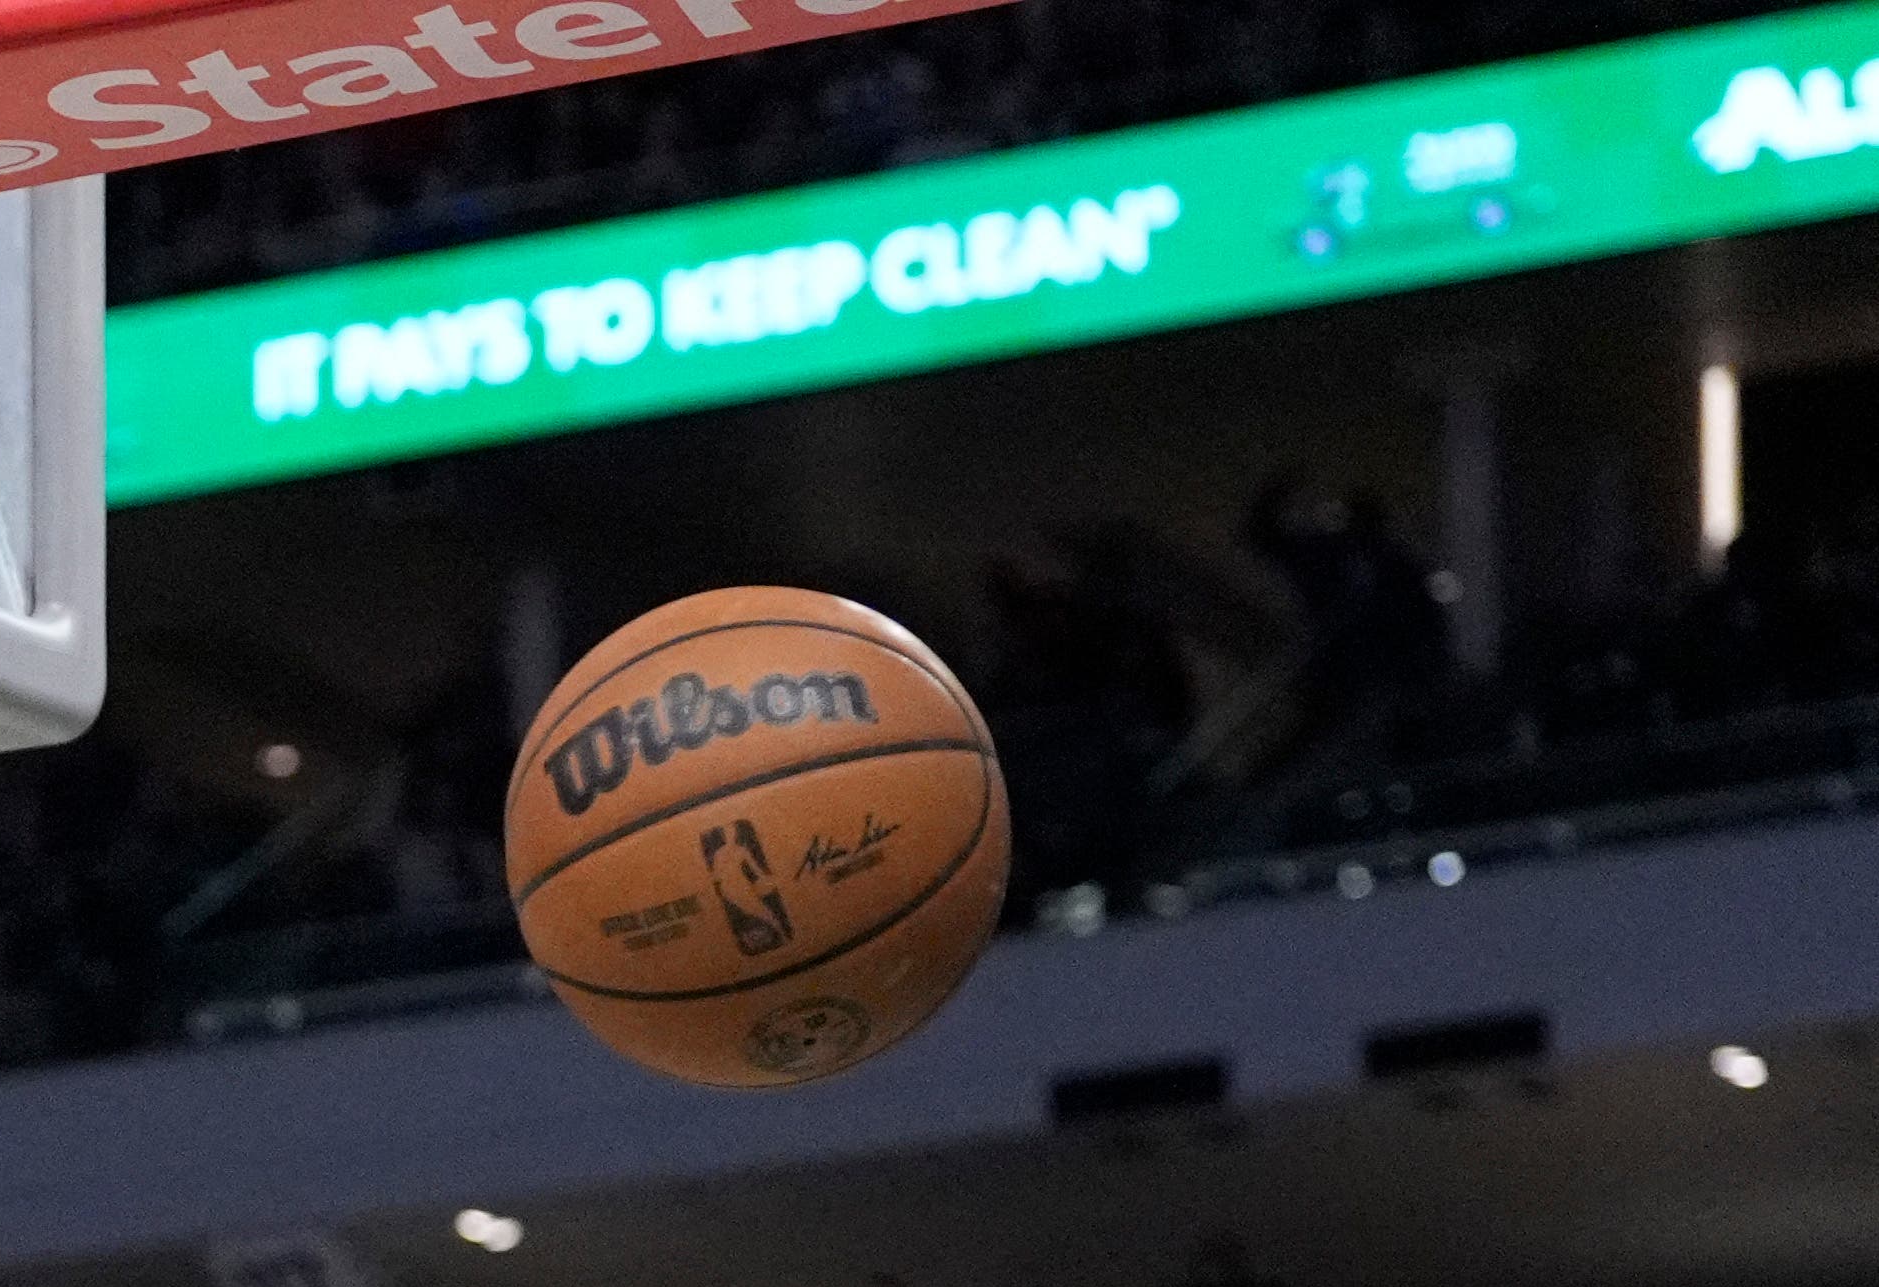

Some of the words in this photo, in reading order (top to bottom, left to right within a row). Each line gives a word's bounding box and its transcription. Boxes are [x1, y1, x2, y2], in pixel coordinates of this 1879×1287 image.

[45, 0, 896, 150] State
[333, 297, 531, 407] PAYS
[533, 277, 654, 371] TO
[661, 240, 867, 351] KEEP
[542, 670, 881, 817] Wilson
